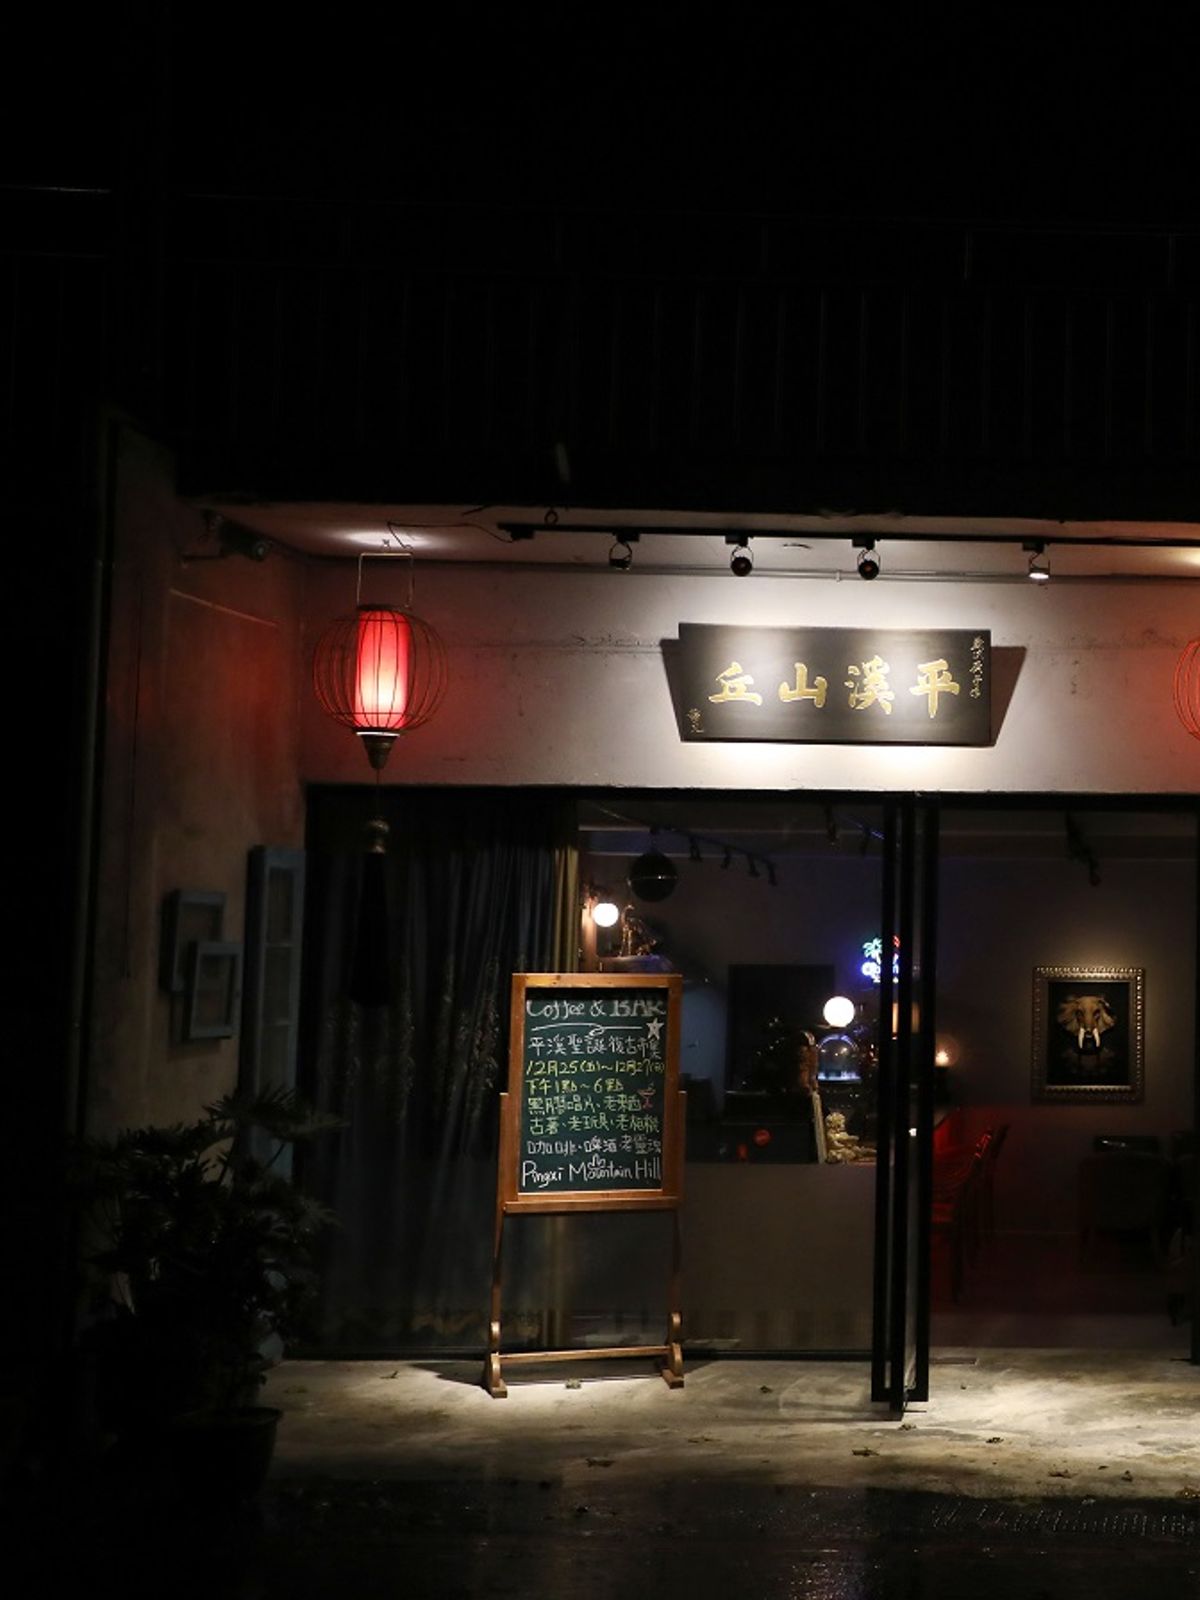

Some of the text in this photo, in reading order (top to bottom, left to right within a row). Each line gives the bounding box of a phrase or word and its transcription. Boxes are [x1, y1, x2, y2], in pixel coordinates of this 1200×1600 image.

[526, 1000, 585, 1020] Coffee
[610, 1000, 666, 1017] BAR
[569, 1160, 633, 1182] Mountain
[635, 1157, 661, 1181] Hill
